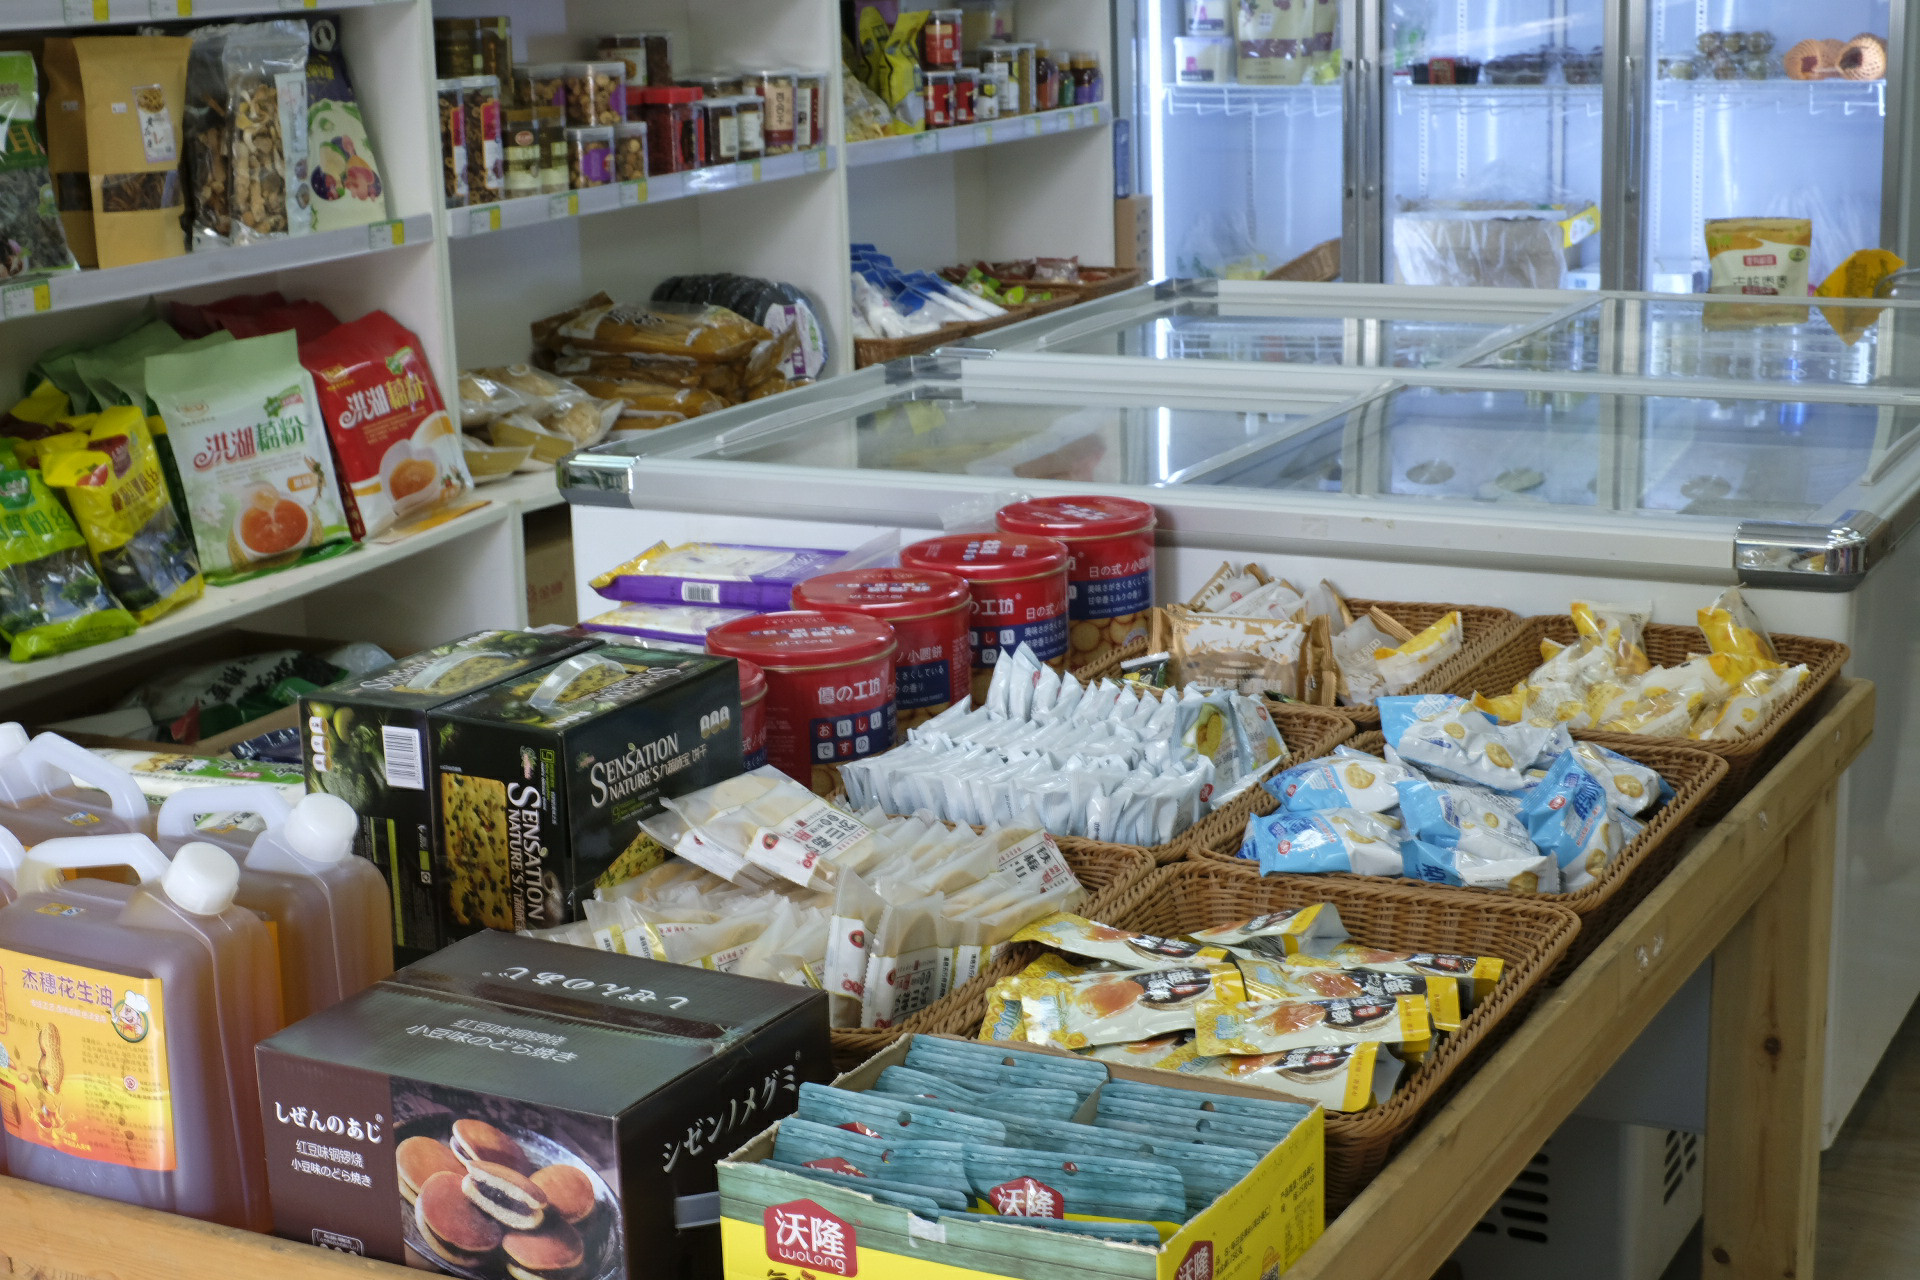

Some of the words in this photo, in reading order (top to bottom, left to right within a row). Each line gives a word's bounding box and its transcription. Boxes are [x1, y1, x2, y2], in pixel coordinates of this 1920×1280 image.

[817, 677, 882, 705] 優の工坊
[818, 711, 882, 738] おいしい
[818, 735, 870, 759] ですの
[590, 732, 679, 808] SENSATION
[507, 782, 545, 921] SENSATION
[21, 968, 113, 1008] 杰穗花生油
[405, 1024, 579, 1063] 小豆味のどら焼き
[275, 1101, 383, 1144] しぜんのあじ
[662, 1064, 798, 1173] シゼンノメグミ
[291, 1157, 372, 1189] 小豆味のどら焼き
[296, 1138, 364, 1169] 红豆味铜锣烧
[998, 1186, 1055, 1219] 沃隆
[774, 1208, 847, 1259] 沃隆
